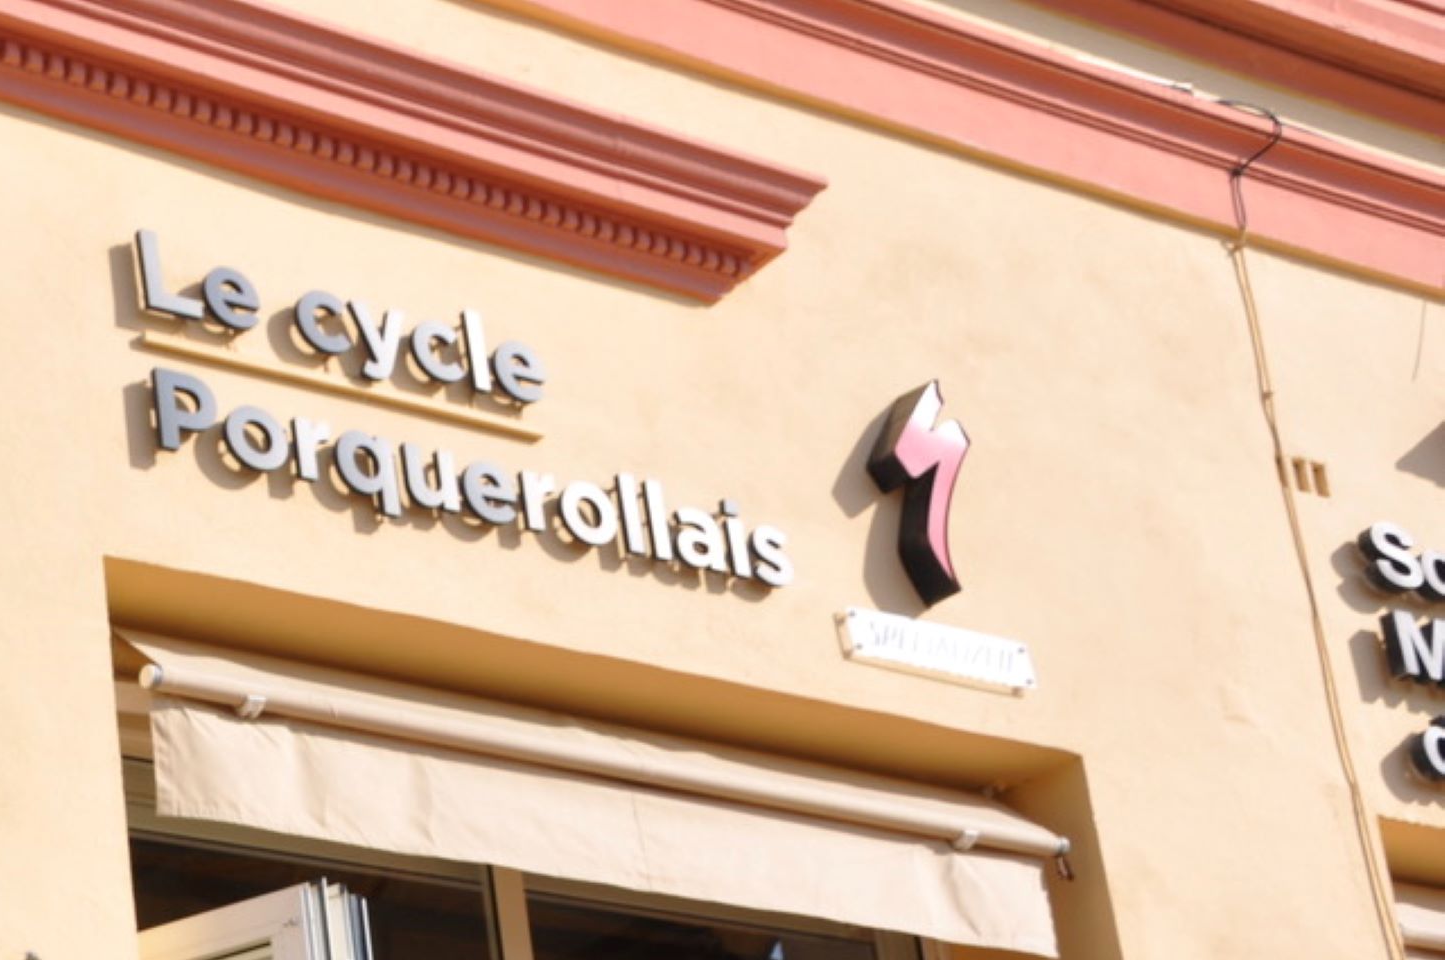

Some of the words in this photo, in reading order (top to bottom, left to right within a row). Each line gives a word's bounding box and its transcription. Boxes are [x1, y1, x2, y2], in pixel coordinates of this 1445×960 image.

[135, 229, 259, 333] Le
[295, 289, 547, 403] cycle
[150, 367, 794, 588] Porquerollais
